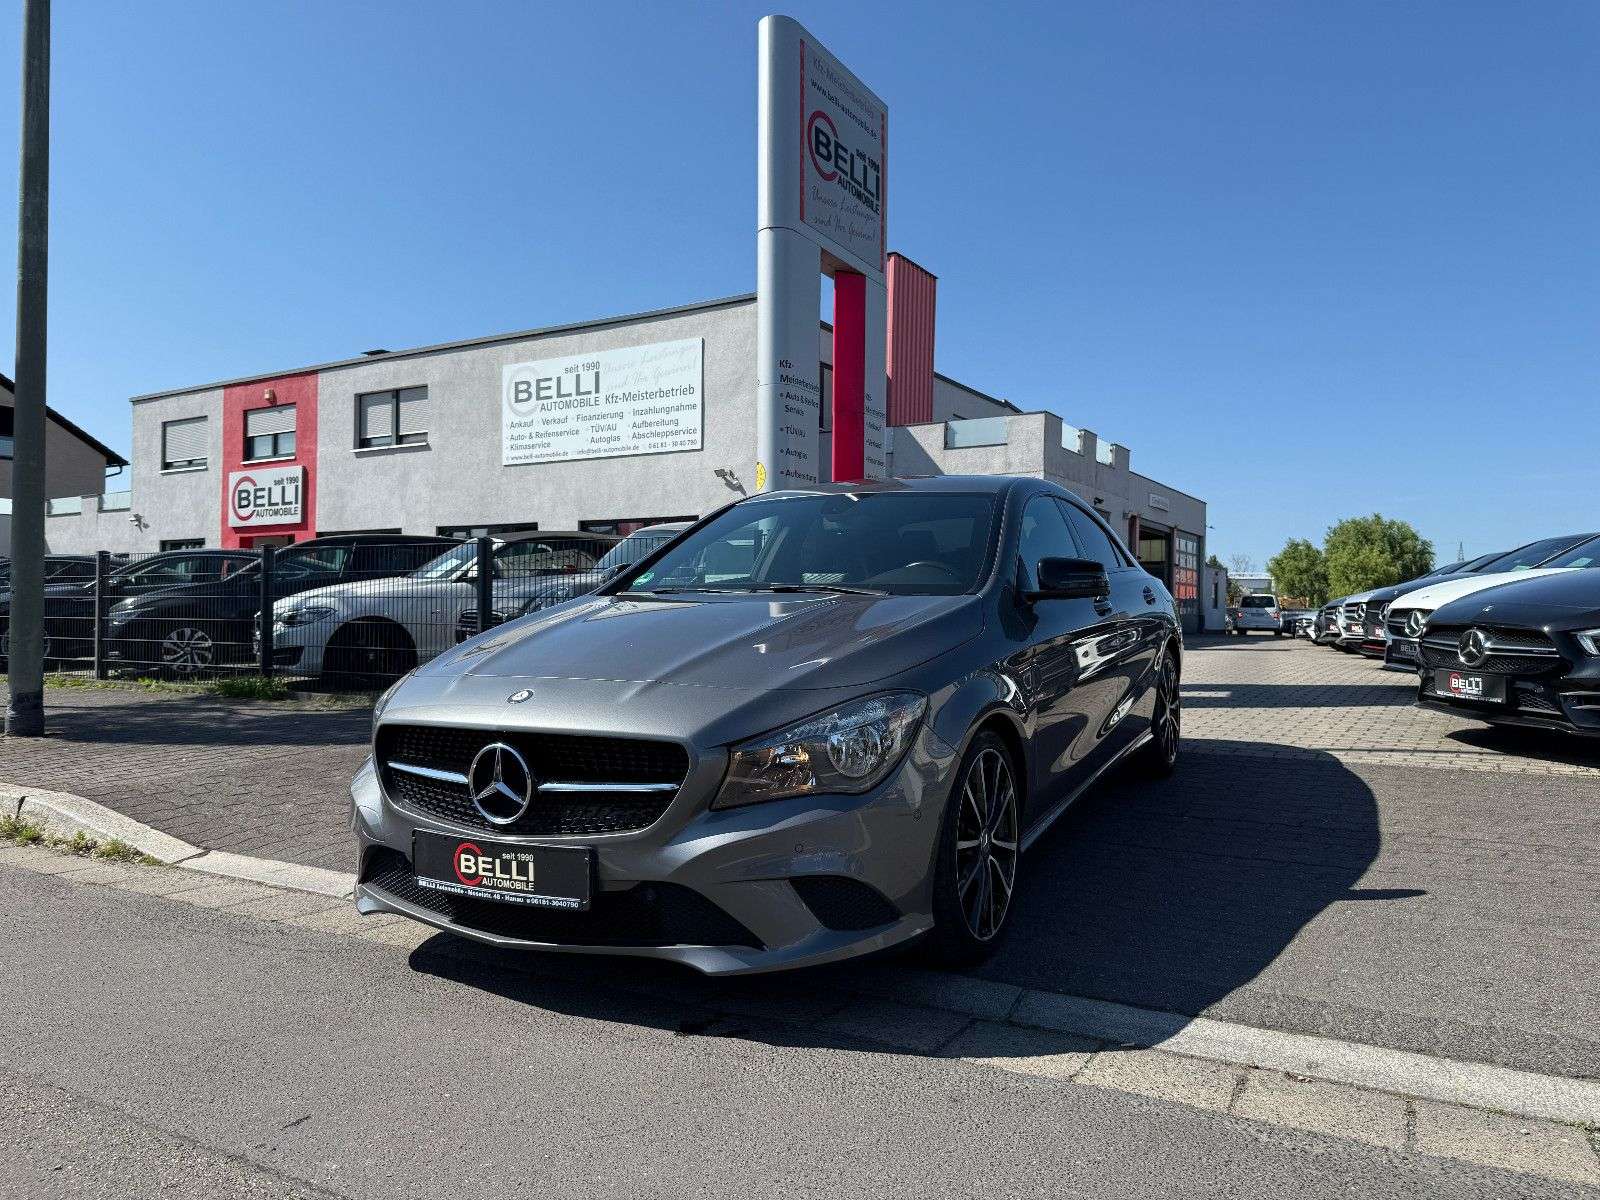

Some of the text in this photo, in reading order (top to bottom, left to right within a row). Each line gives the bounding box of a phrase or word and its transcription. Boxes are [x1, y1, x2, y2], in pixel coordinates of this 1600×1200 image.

[815, 125, 880, 201] BELLI
[837, 175, 880, 216] AUTOMOBILE
[564, 361, 600, 375] seit 1990
[514, 371, 600, 404] BELLI
[605, 384, 695, 405] Kfz-Meisterbetrieb
[540, 397, 600, 413] AUTOMOBILE
[632, 402, 697, 417] Inzahlungnahme
[510, 411, 624, 430] Ankauf Verkauf Finanzierung
[535, 428, 580, 439] Reifenservice
[590, 423, 617, 434] TÜV/AU
[632, 418, 679, 430] Aufbereitung
[510, 427, 698, 451] Klimaservice Autoglas Abschleppservice
[286, 475, 299, 485] 1990
[238, 484, 299, 509] BELLI
[255, 506, 299, 518] AUTOMOBILE
[1452, 678, 1482, 691] BELLI
[502, 852, 534, 862] seit 1990
[460, 853, 535, 882] BELLI
[481, 877, 535, 891] AUTOMOBILE
